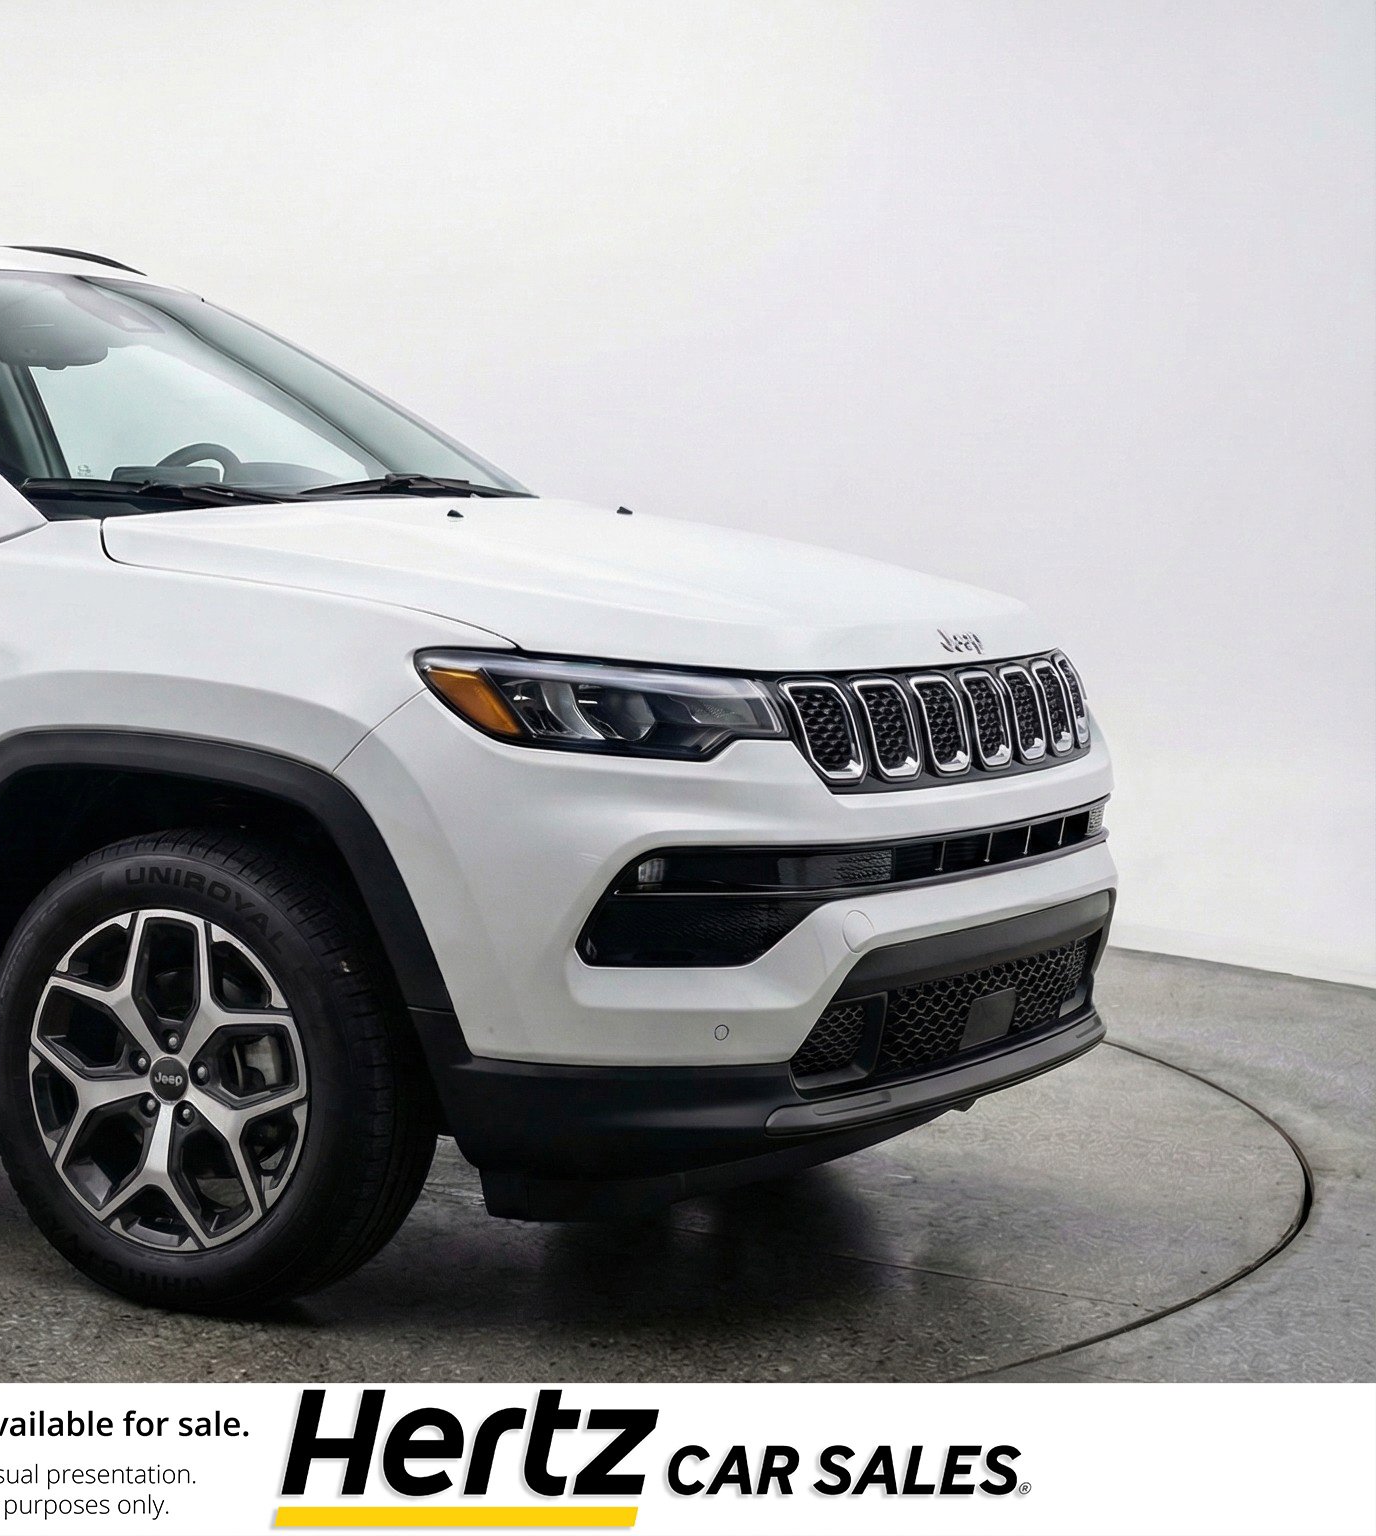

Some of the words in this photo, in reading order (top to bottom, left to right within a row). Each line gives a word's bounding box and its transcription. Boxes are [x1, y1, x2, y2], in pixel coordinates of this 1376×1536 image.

[936, 628, 984, 655] Jeep
[125, 866, 284, 955] UNIROYAL
[154, 1072, 183, 1087] Jeep
